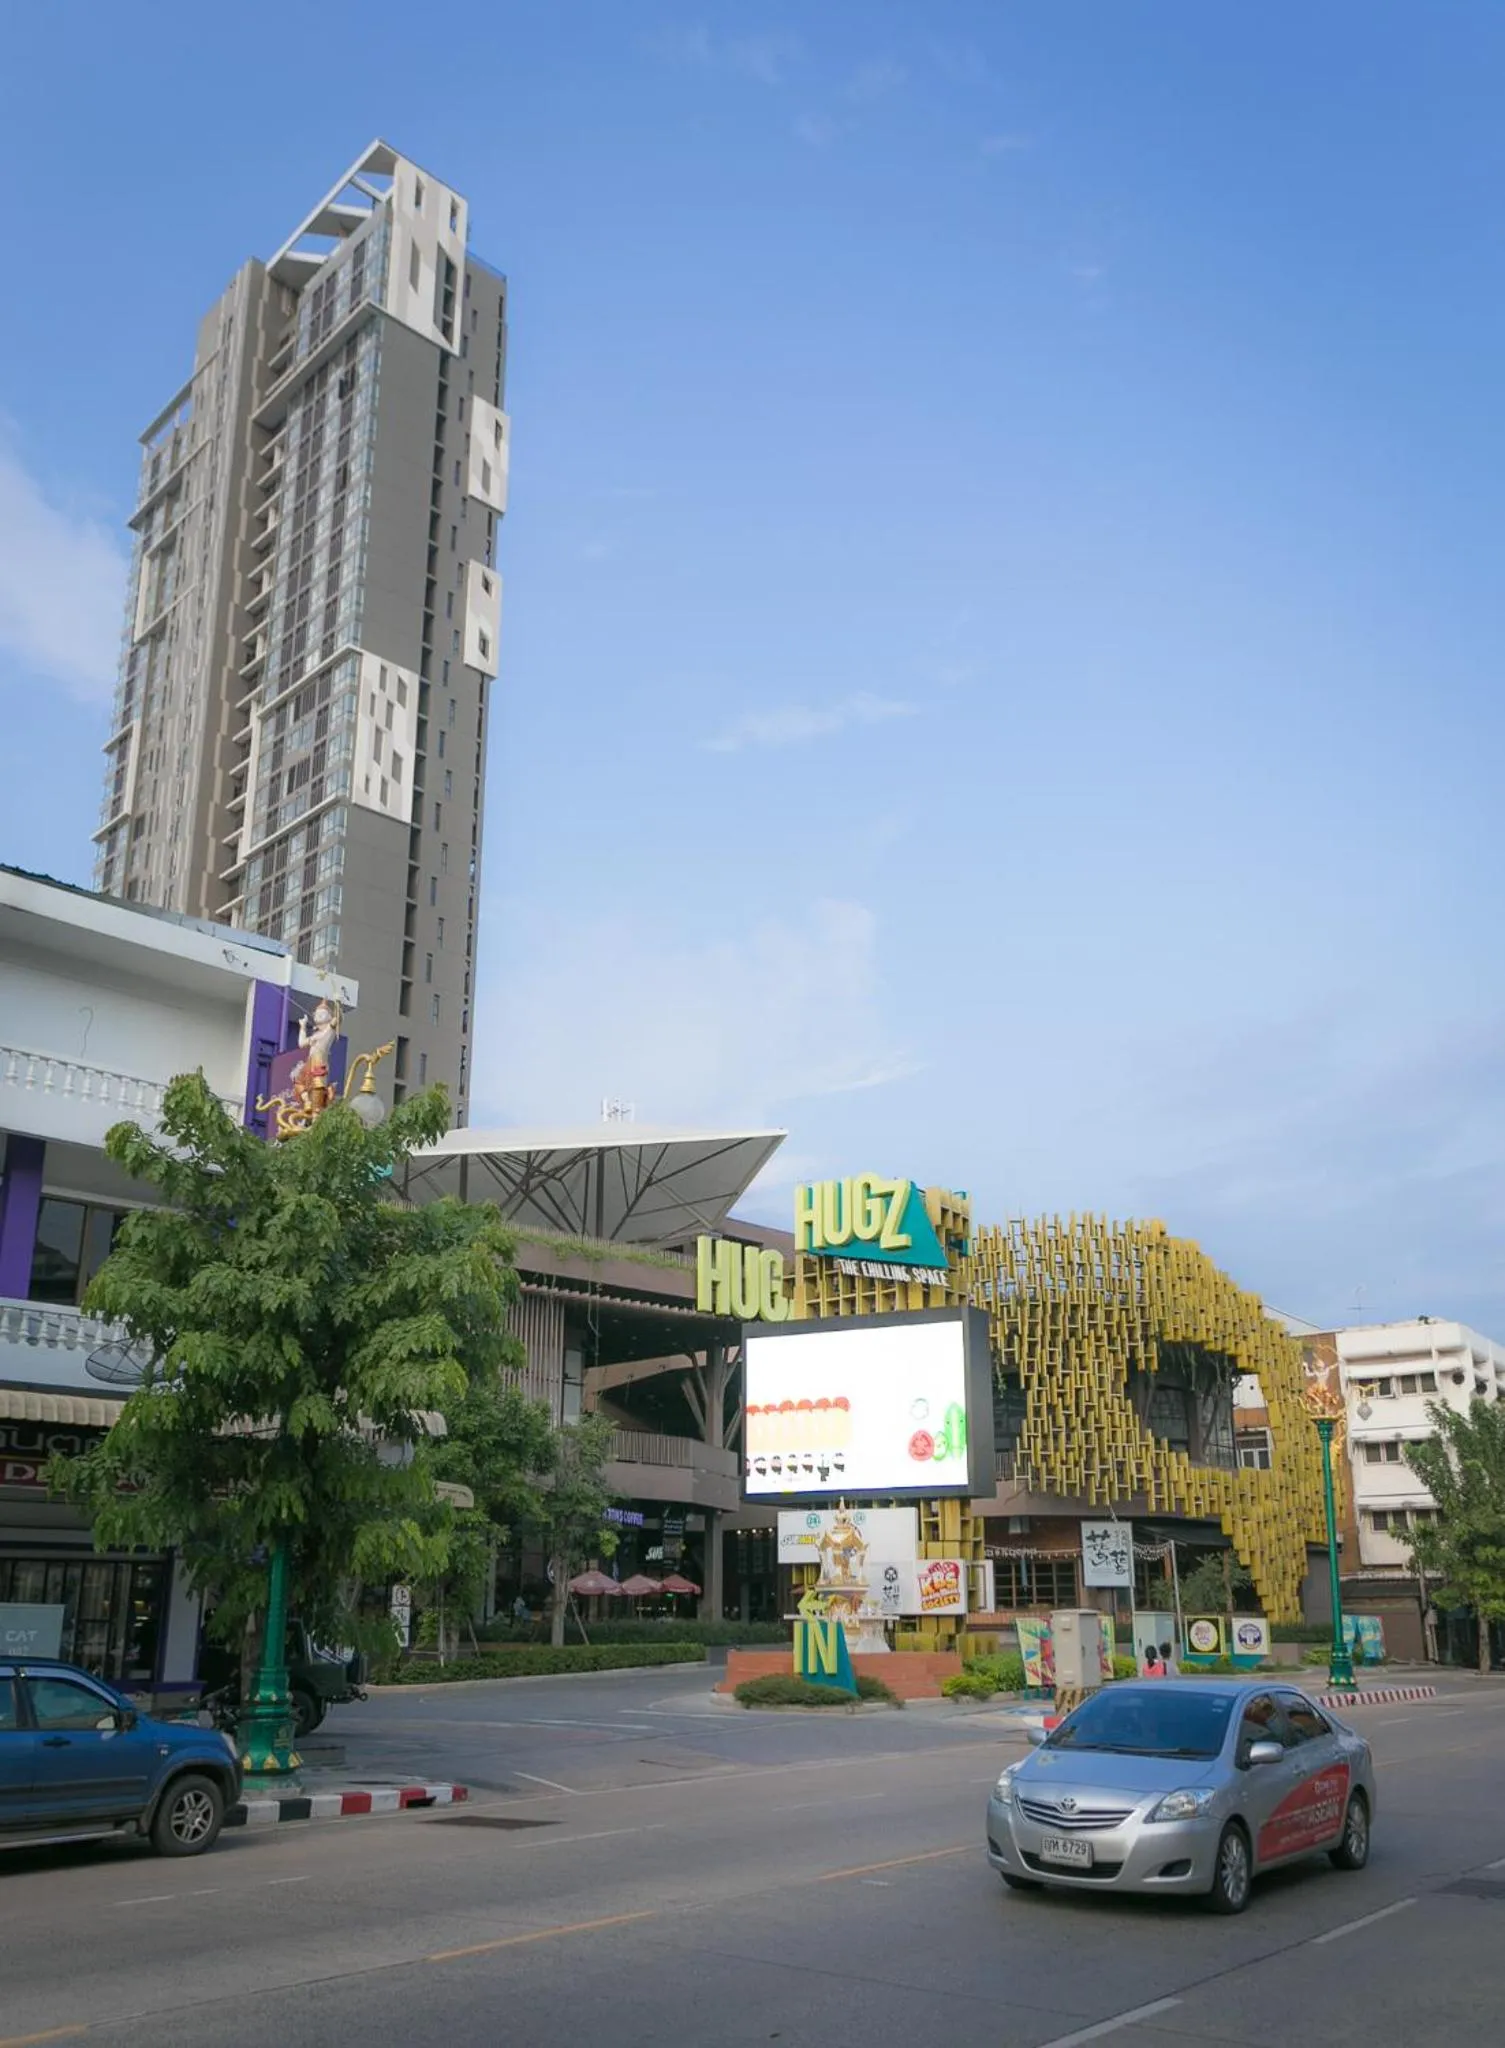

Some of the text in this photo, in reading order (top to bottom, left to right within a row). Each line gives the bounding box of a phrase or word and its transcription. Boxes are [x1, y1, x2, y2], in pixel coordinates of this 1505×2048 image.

[795, 1171, 912, 1251] HUGZ
[838, 1258, 950, 1287] THE CHILLING SPACE
[793, 1618, 837, 1675] IN
[1062, 1840, 1087, 1856] 6729
